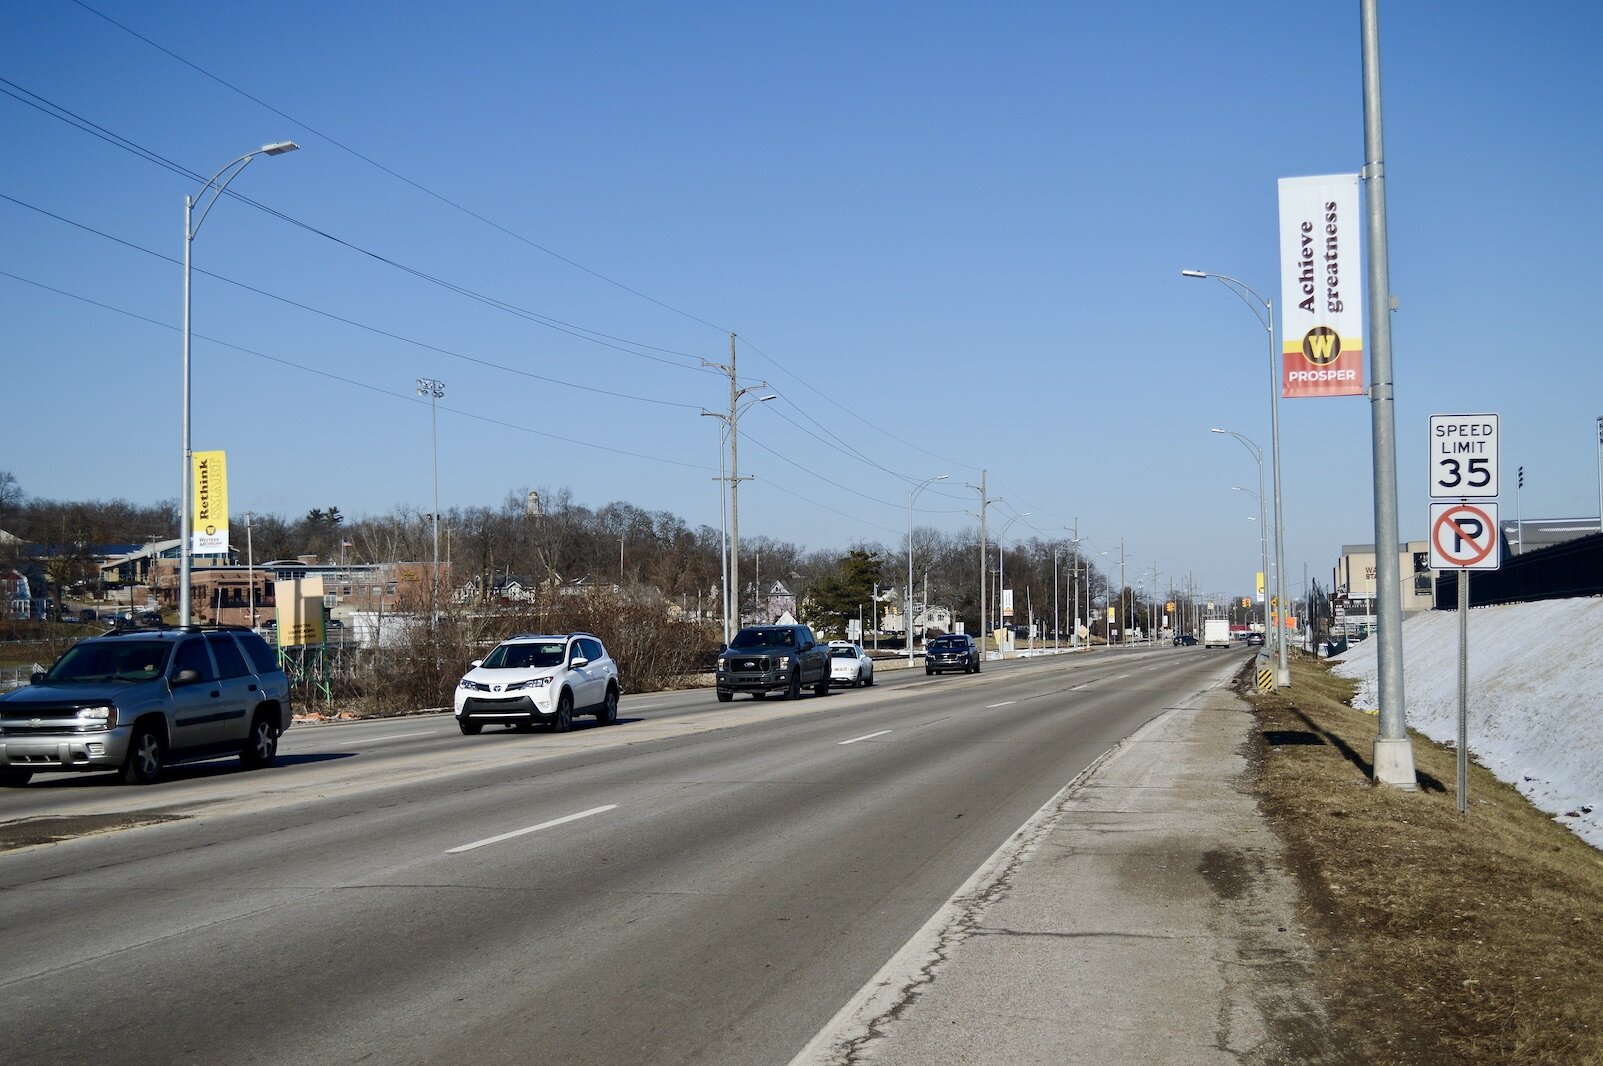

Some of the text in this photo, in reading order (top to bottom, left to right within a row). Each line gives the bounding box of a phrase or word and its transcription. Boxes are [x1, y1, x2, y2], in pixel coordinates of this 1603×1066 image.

[1298, 221, 1314, 315] Achieve
[1325, 201, 1343, 314] greatness
[1308, 335, 1335, 358] W
[1289, 370, 1355, 381] PROSPER
[1435, 424, 1492, 437] SPEED
[1442, 442, 1486, 453] LIMIT
[1438, 459, 1491, 487] 35
[200, 459, 209, 520] Rethink
